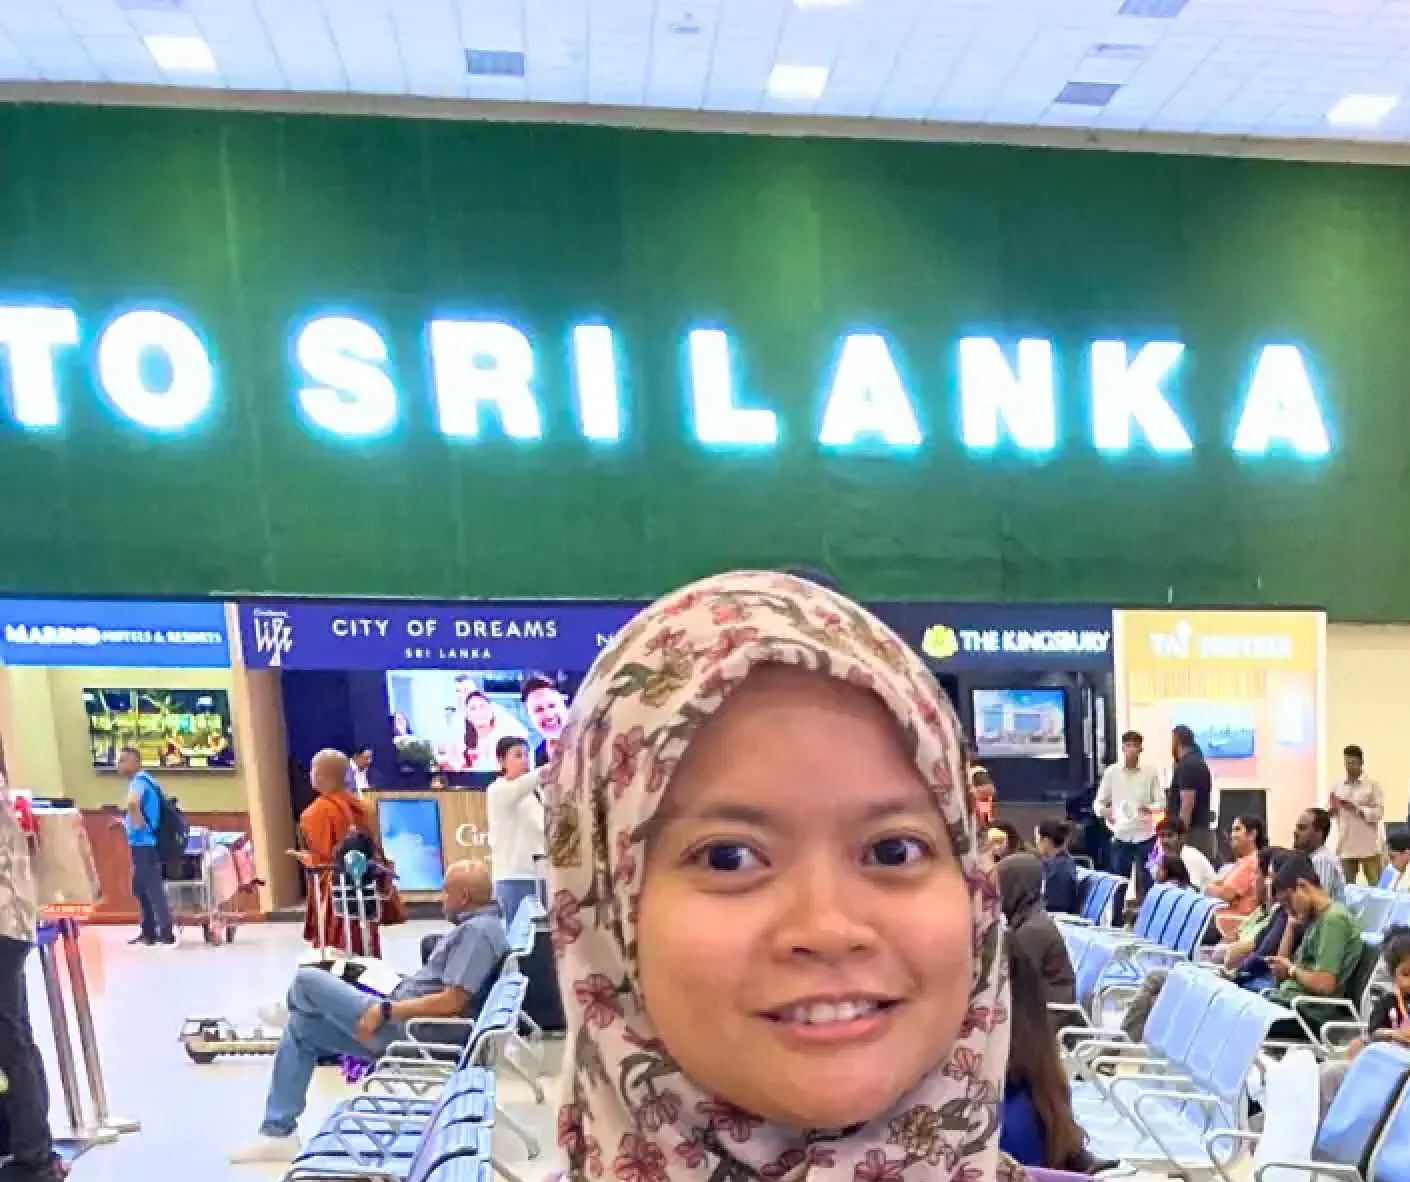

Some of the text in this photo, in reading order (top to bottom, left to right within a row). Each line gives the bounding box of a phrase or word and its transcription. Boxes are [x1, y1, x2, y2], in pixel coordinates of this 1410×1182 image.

[0, 305, 1332, 458] TO SRI LANKA
[331, 618, 558, 639] CITY OF DREAMS
[959, 629, 1111, 652] THE KINGSBURY
[405, 648, 491, 659] SRI LANKA
